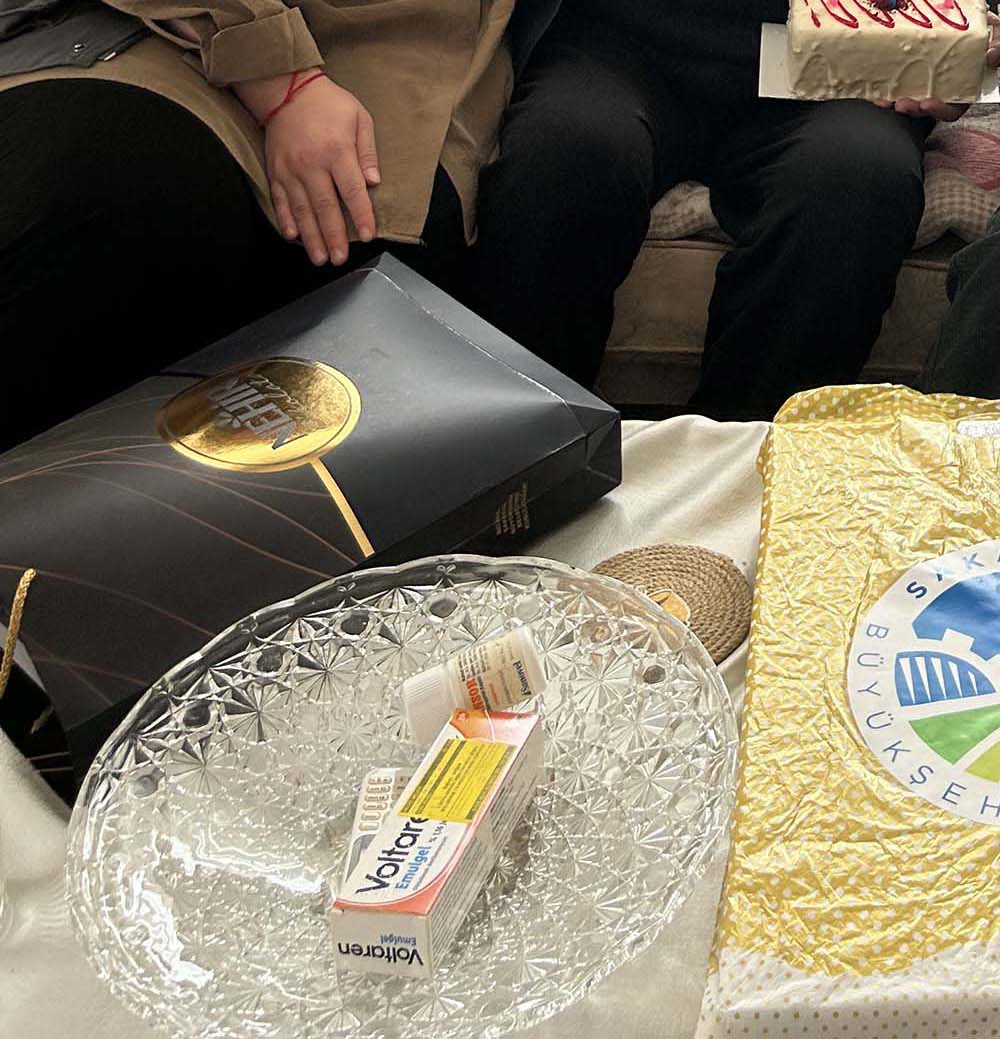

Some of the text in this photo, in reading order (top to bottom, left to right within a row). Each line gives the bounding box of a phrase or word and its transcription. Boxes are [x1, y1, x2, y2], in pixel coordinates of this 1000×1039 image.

[395, 846, 432, 889] Emulgel
[380, 934, 416, 946] Emulgel
[338, 942, 424, 966] Voltaren
